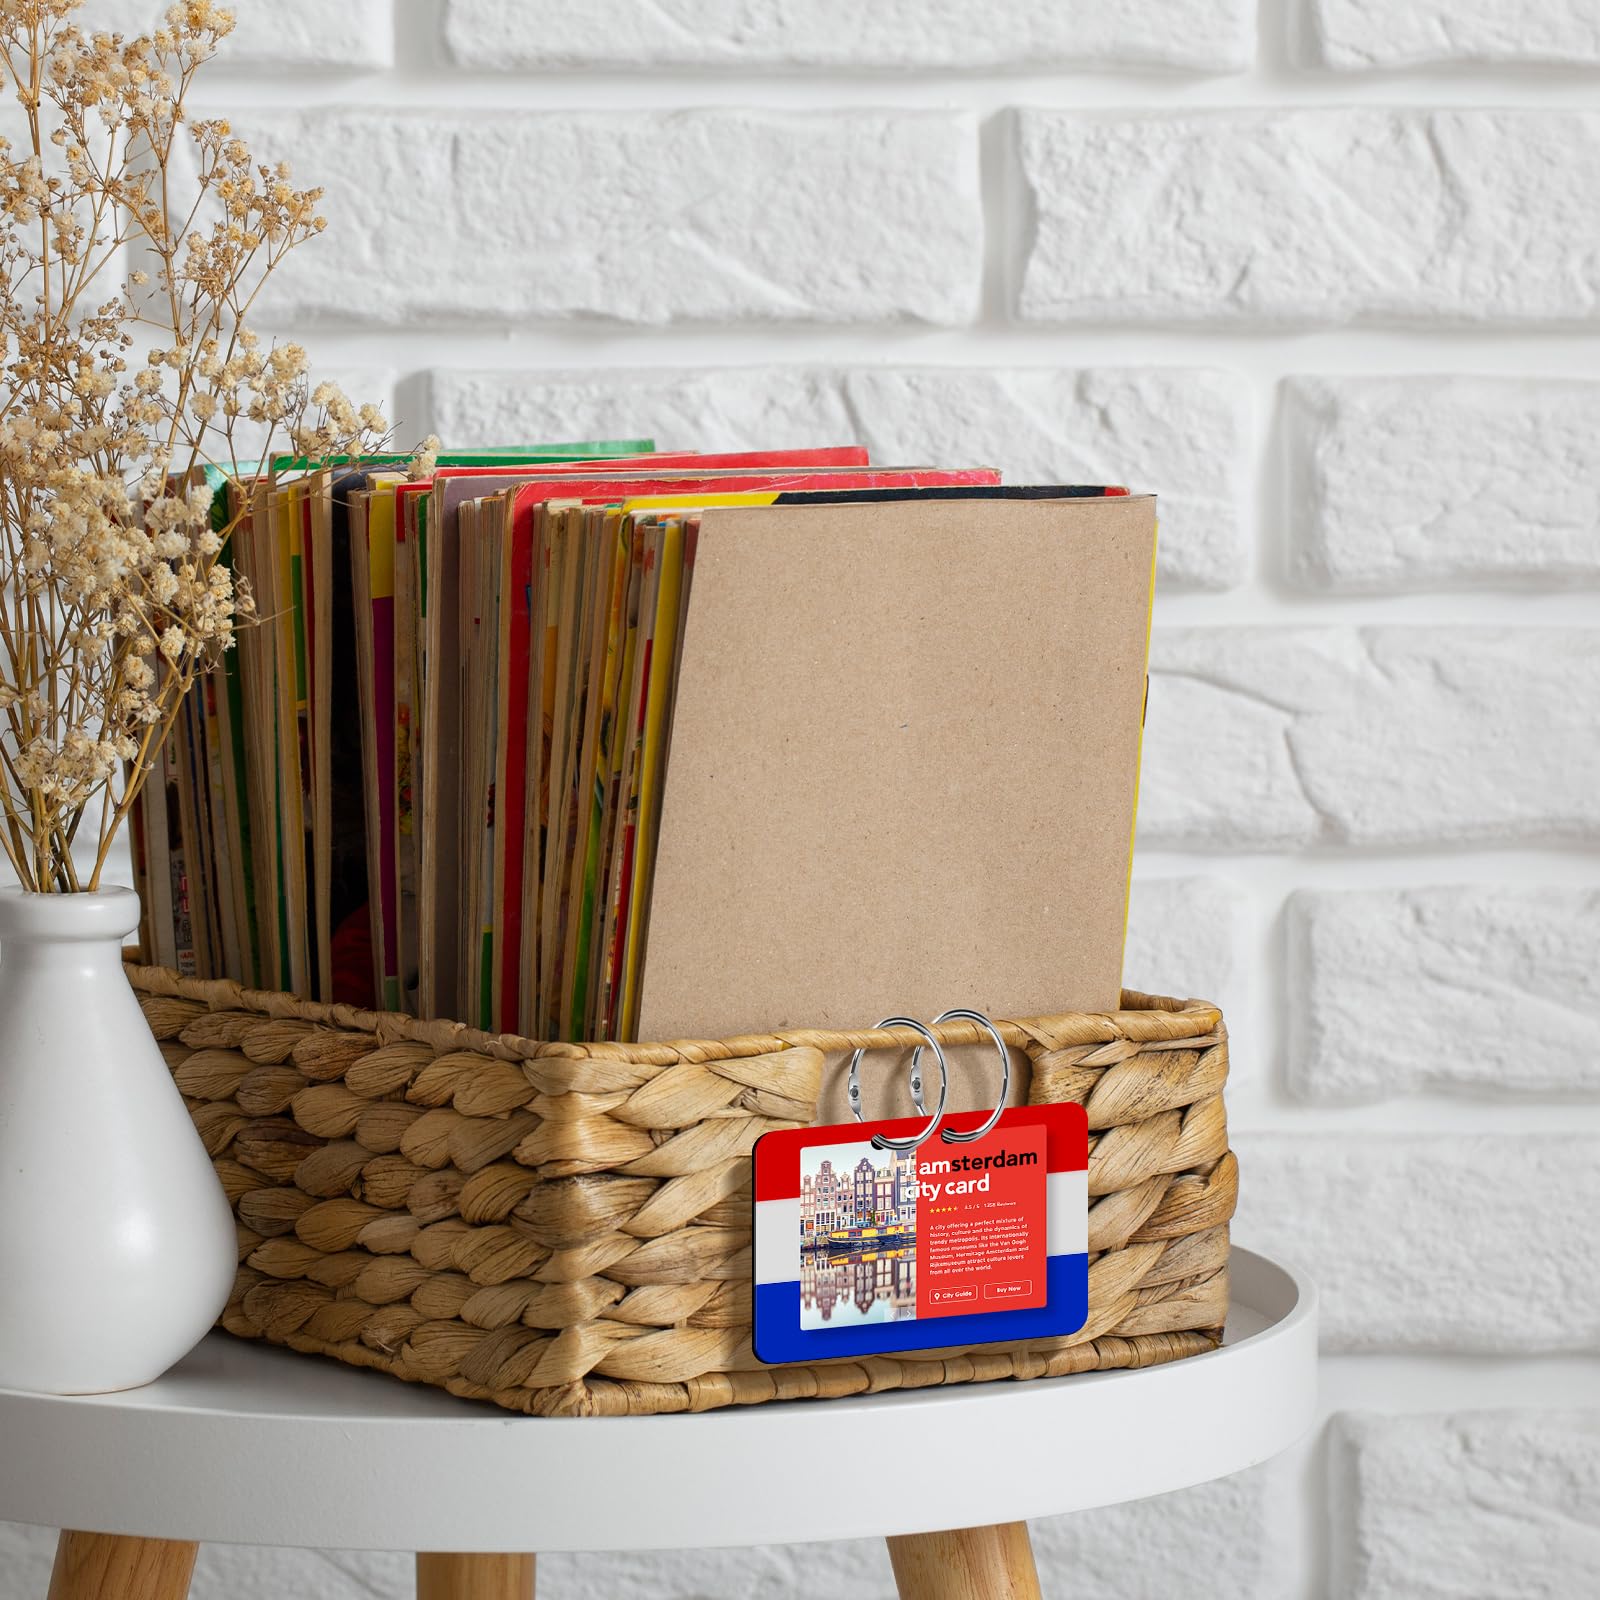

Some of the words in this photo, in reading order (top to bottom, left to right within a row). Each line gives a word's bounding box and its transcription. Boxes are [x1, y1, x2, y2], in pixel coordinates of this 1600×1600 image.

[919, 1150, 1038, 1175] amsterdam
[905, 1180, 942, 1202] city
[945, 1173, 990, 1195] card
[946, 1222, 968, 1230] offering
[994, 1224, 1020, 1232] dynamics
[989, 1232, 1028, 1240] internationally
[930, 1260, 966, 1268] Rijksmuseum
